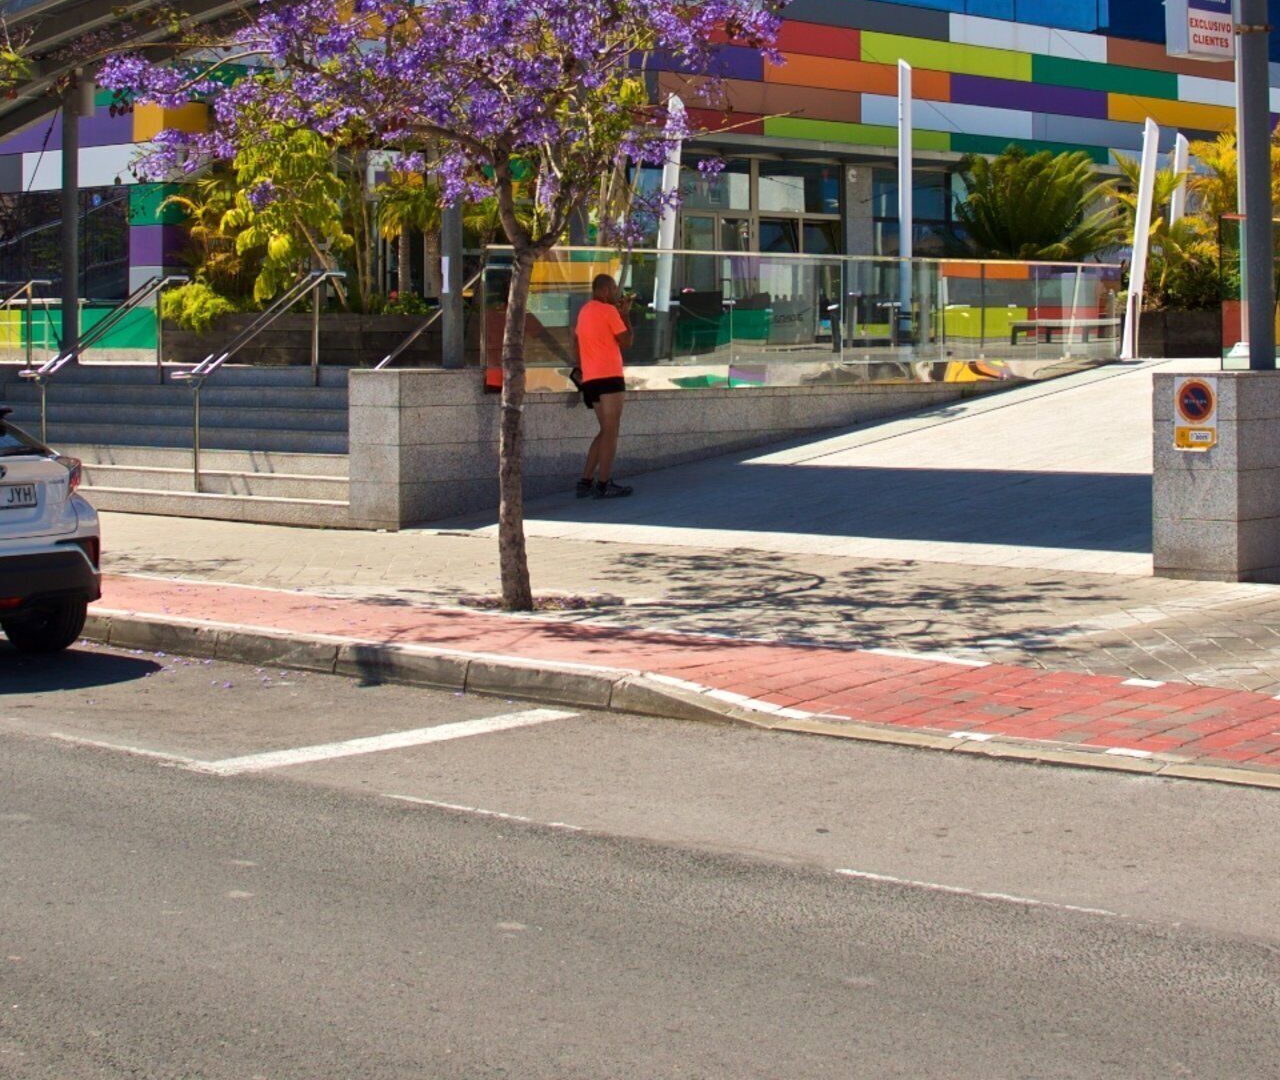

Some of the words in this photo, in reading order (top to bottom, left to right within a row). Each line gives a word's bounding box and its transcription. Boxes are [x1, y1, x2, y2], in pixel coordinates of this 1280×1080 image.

[1189, 17, 1232, 34] EXCLUSIVO
[1192, 33, 1230, 49] CLIENTES
[7, 487, 33, 504] JYH
